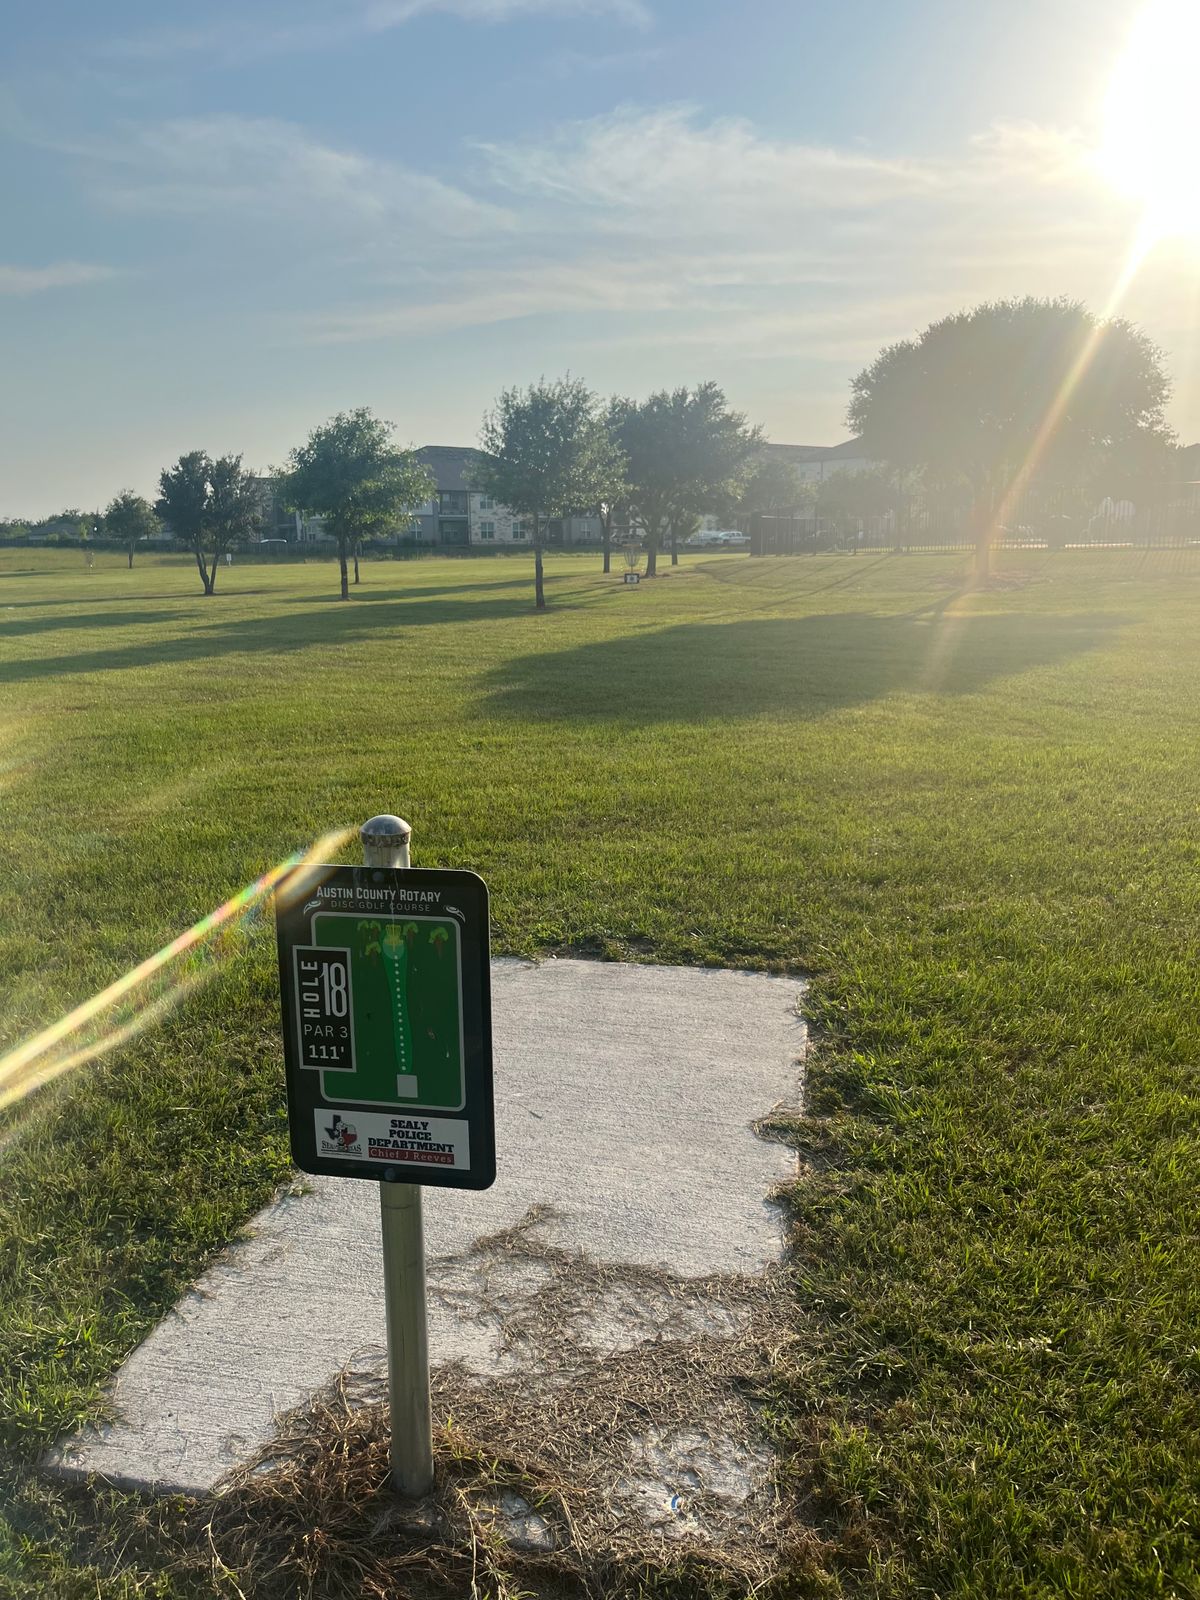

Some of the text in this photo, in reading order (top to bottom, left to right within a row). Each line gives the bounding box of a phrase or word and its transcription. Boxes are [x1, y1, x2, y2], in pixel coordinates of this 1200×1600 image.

[316, 886, 441, 902] AUSTIN COUNTY ROTARY
[331, 900, 430, 912] DISC GOLF COURSE
[301, 961, 320, 1018] HOLE
[319, 962, 348, 1017] 18
[304, 1024, 348, 1038] PAR 3
[390, 1119, 429, 1131] SEALY
[389, 1129, 432, 1141] POLICE
[368, 1137, 455, 1153] DEPARTMENT
[370, 1148, 399, 1159] Chief
[403, 1152, 409, 1160] J
[413, 1152, 452, 1163] Reeves
